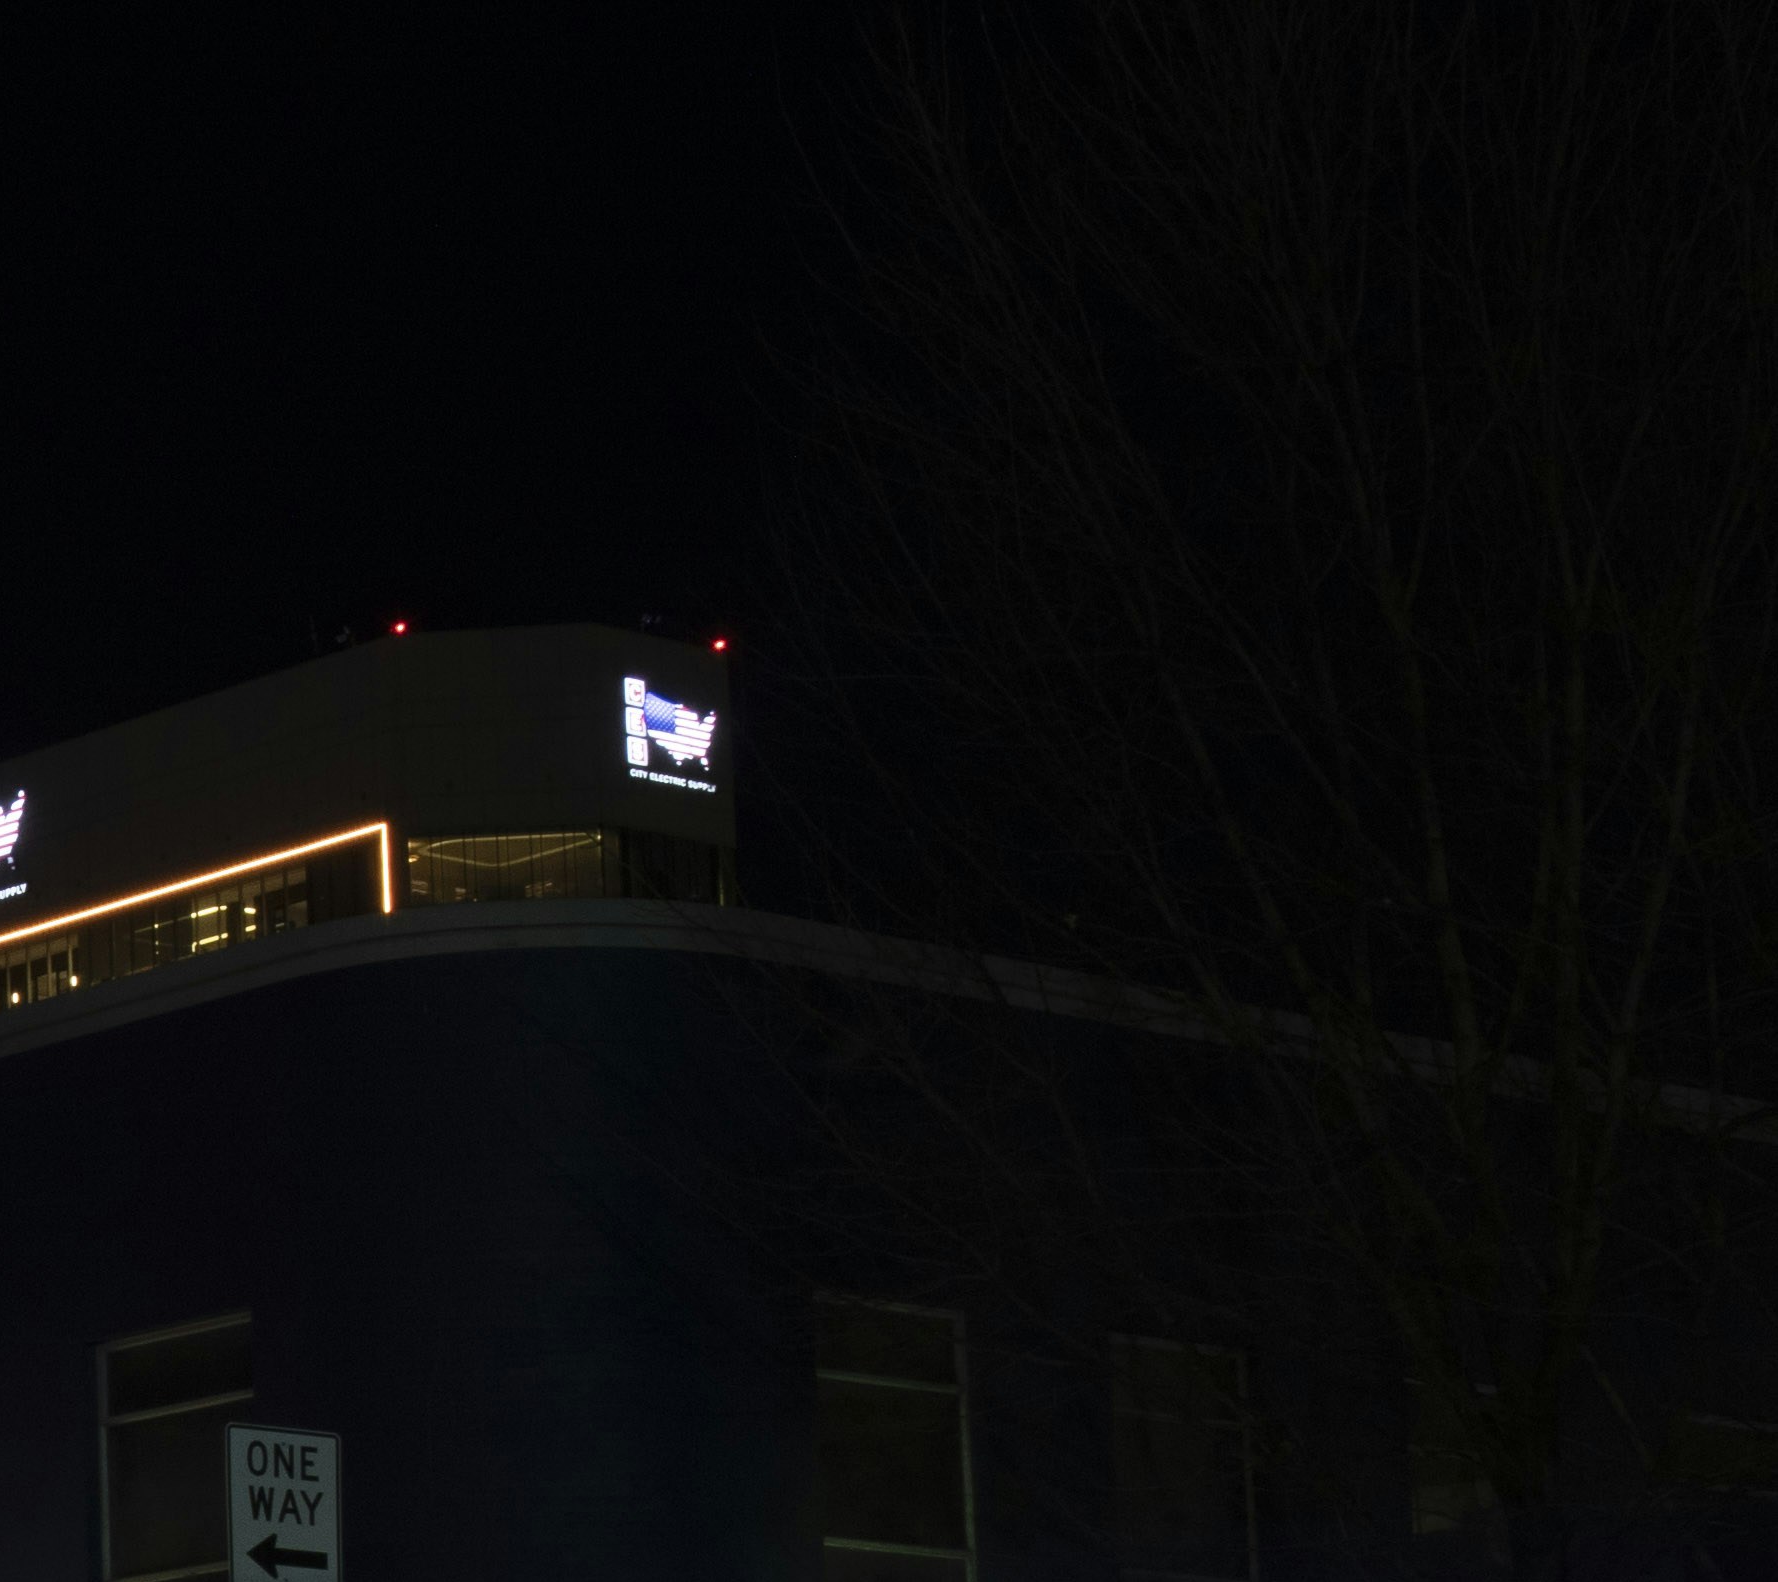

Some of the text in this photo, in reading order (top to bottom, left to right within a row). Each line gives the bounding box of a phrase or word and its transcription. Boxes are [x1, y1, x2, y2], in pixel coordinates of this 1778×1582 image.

[629, 768, 648, 779] CITY
[649, 771, 687, 787] ELECTRIC
[247, 1440, 320, 1482] ONE
[248, 1485, 324, 1527] WAY
